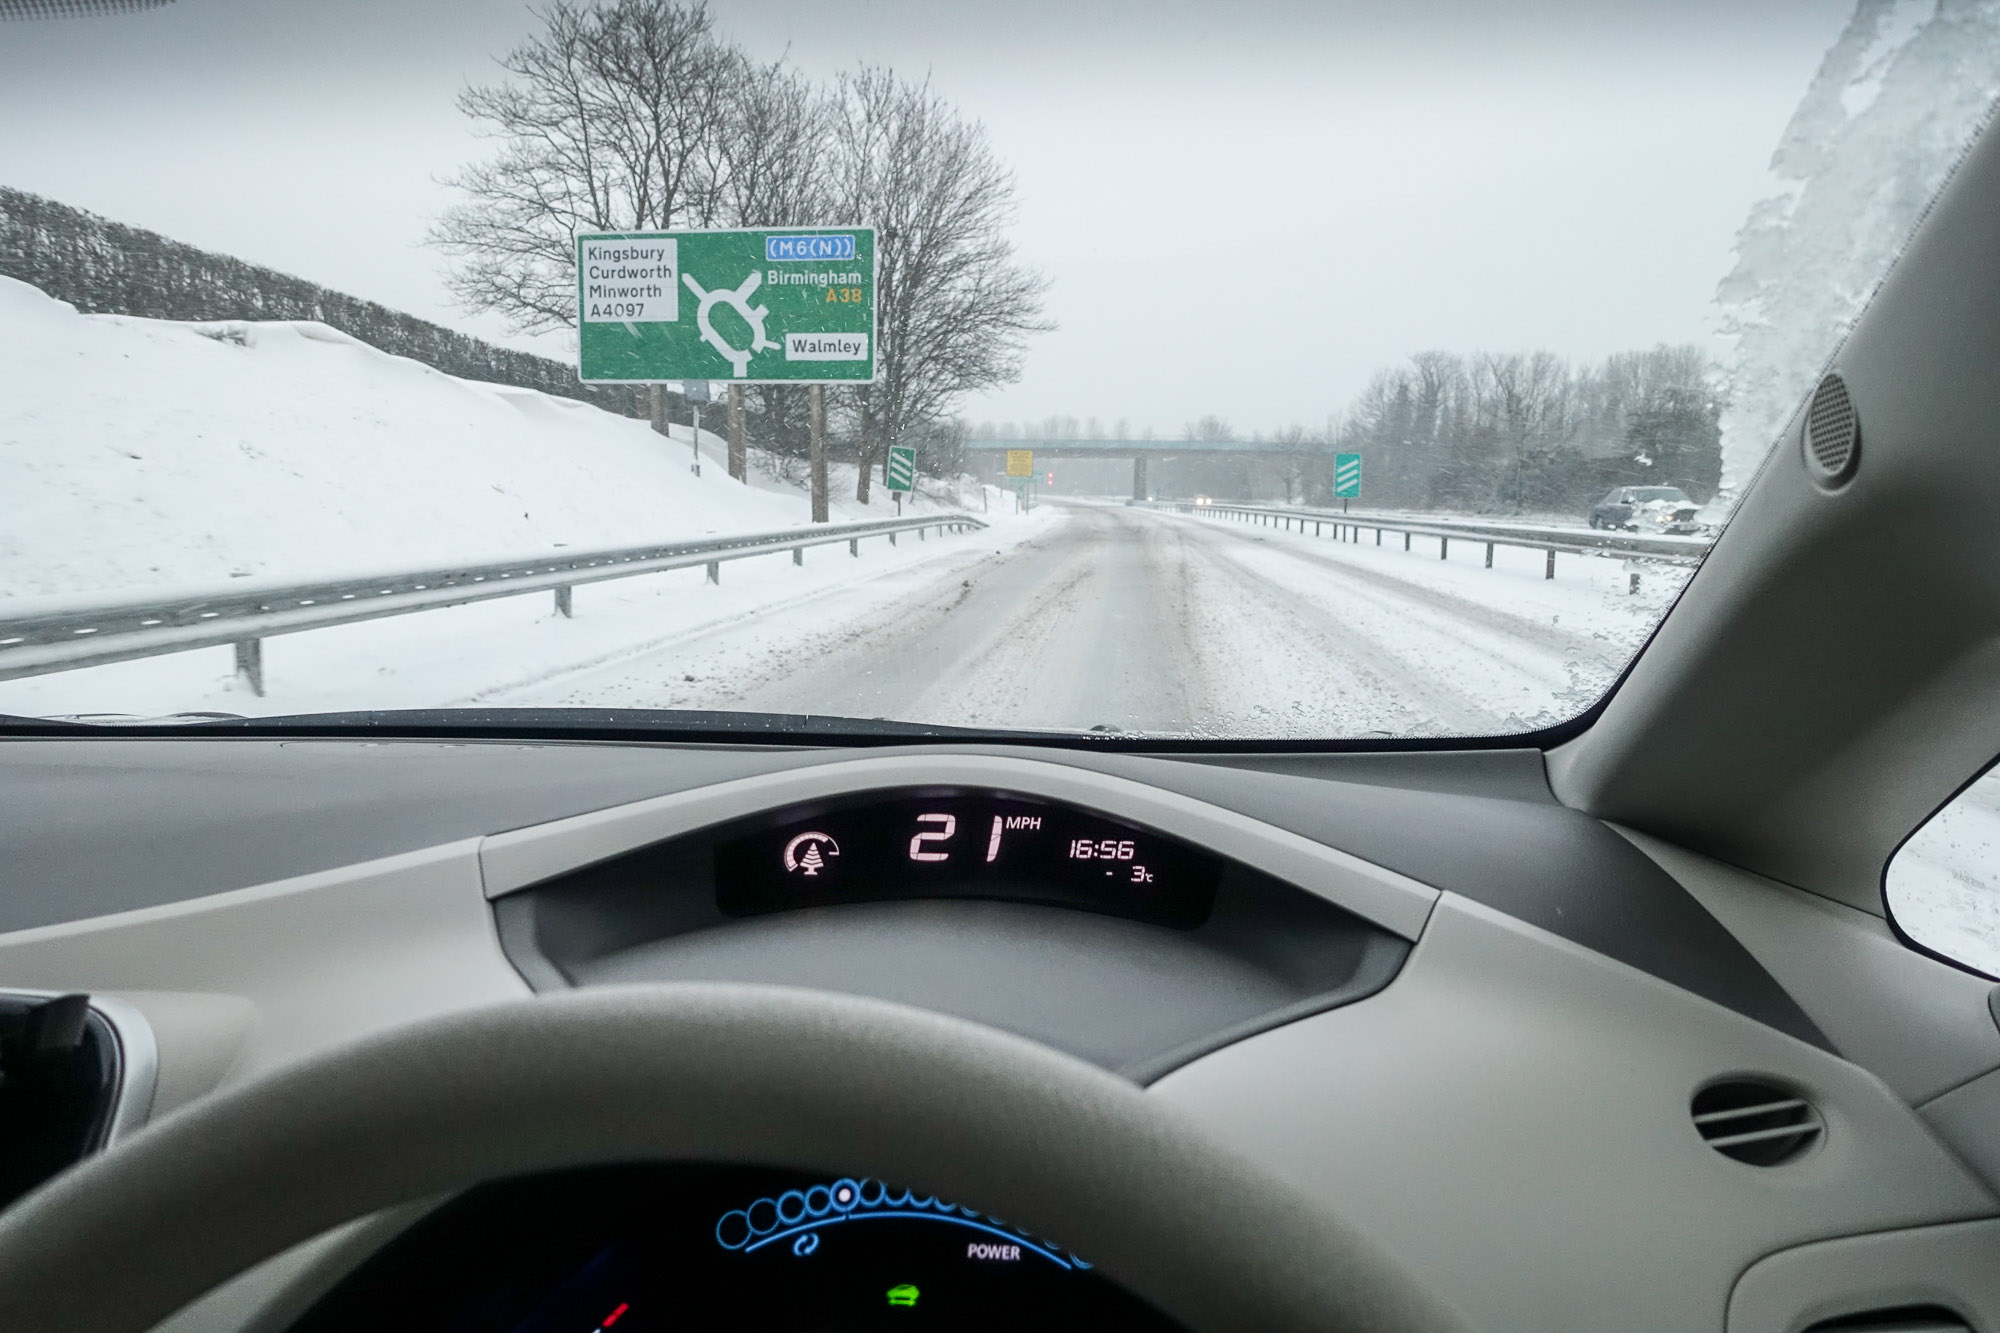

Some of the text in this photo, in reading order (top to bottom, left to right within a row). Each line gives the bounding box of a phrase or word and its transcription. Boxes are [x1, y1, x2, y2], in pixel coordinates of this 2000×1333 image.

[588, 246, 664, 262] Kingsbury
[589, 264, 672, 280] Curdworth
[767, 270, 862, 288] Birmingham
[589, 283, 662, 299] Minworth
[825, 287, 862, 304] A38
[590, 303, 645, 318] A4097
[792, 339, 862, 356] Walmley
[909, 813, 1042, 863] 21 MPH
[1069, 839, 1135, 860] 16:56
[967, 1243, 1021, 1261] POWER
